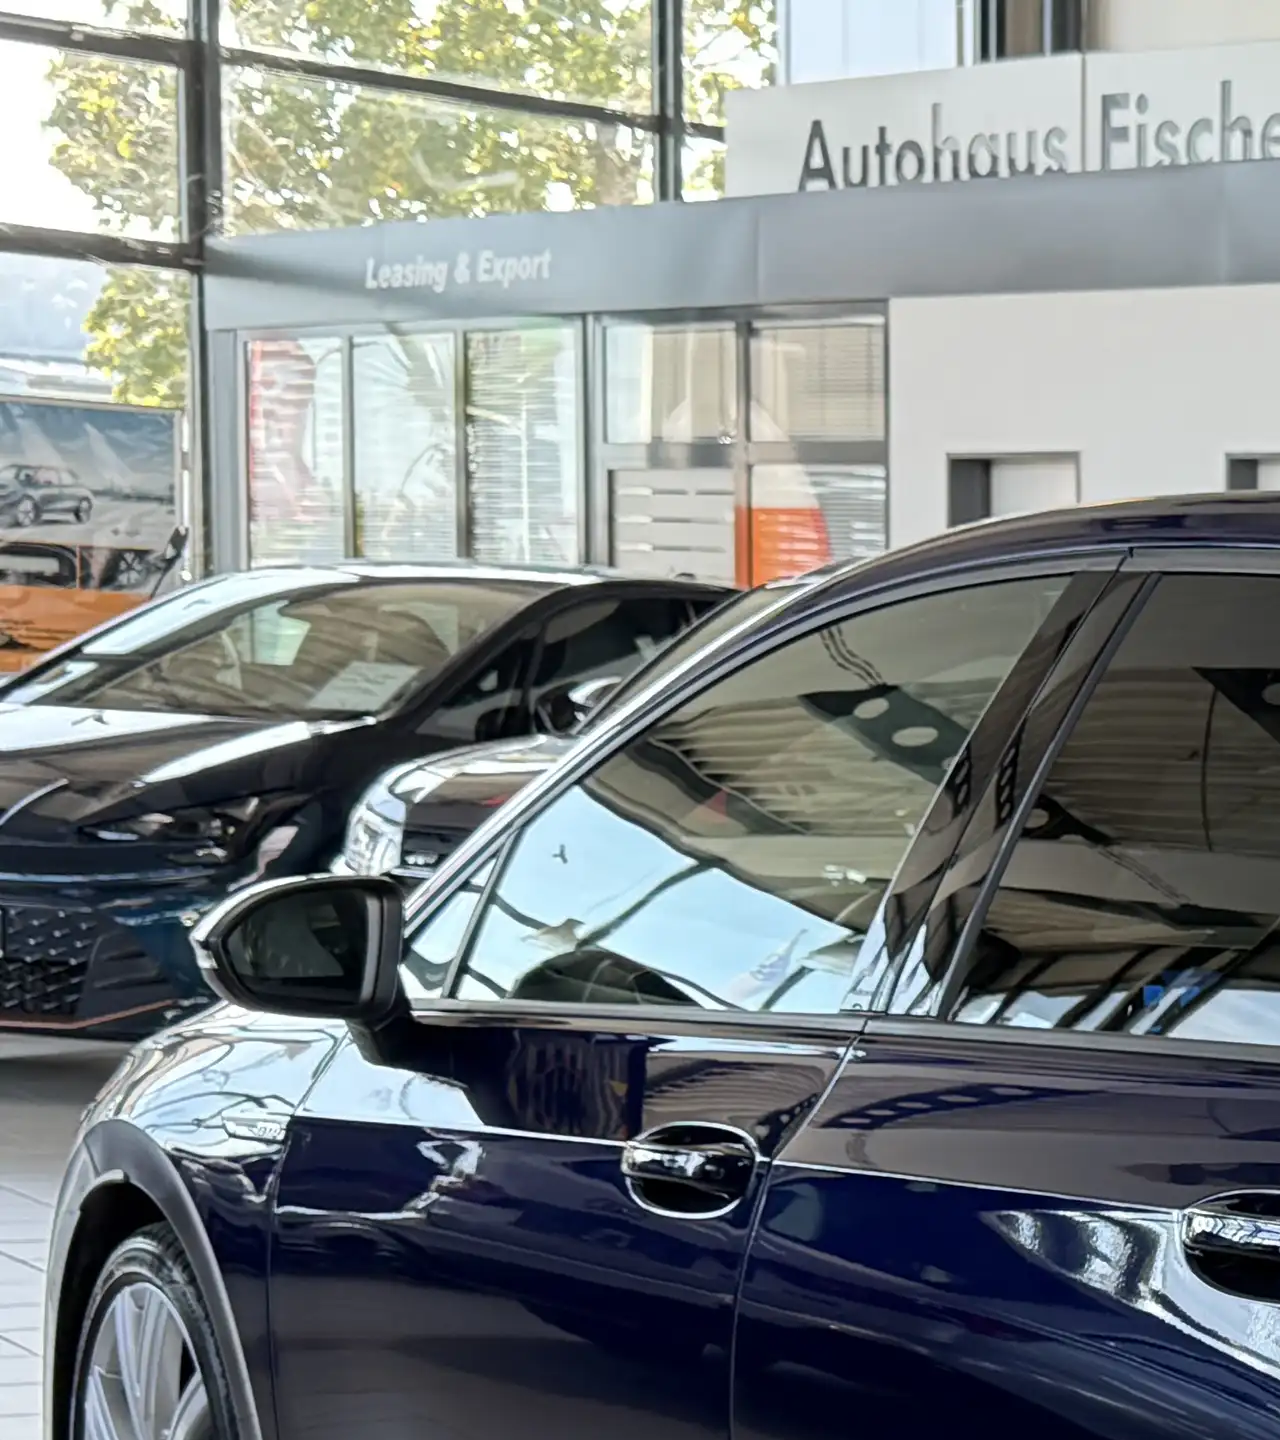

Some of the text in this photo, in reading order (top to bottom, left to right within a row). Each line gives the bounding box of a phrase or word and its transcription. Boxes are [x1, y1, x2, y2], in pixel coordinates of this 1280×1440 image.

[798, 102, 1069, 192] Autohaus
[365, 249, 552, 293] Leasing & Export
